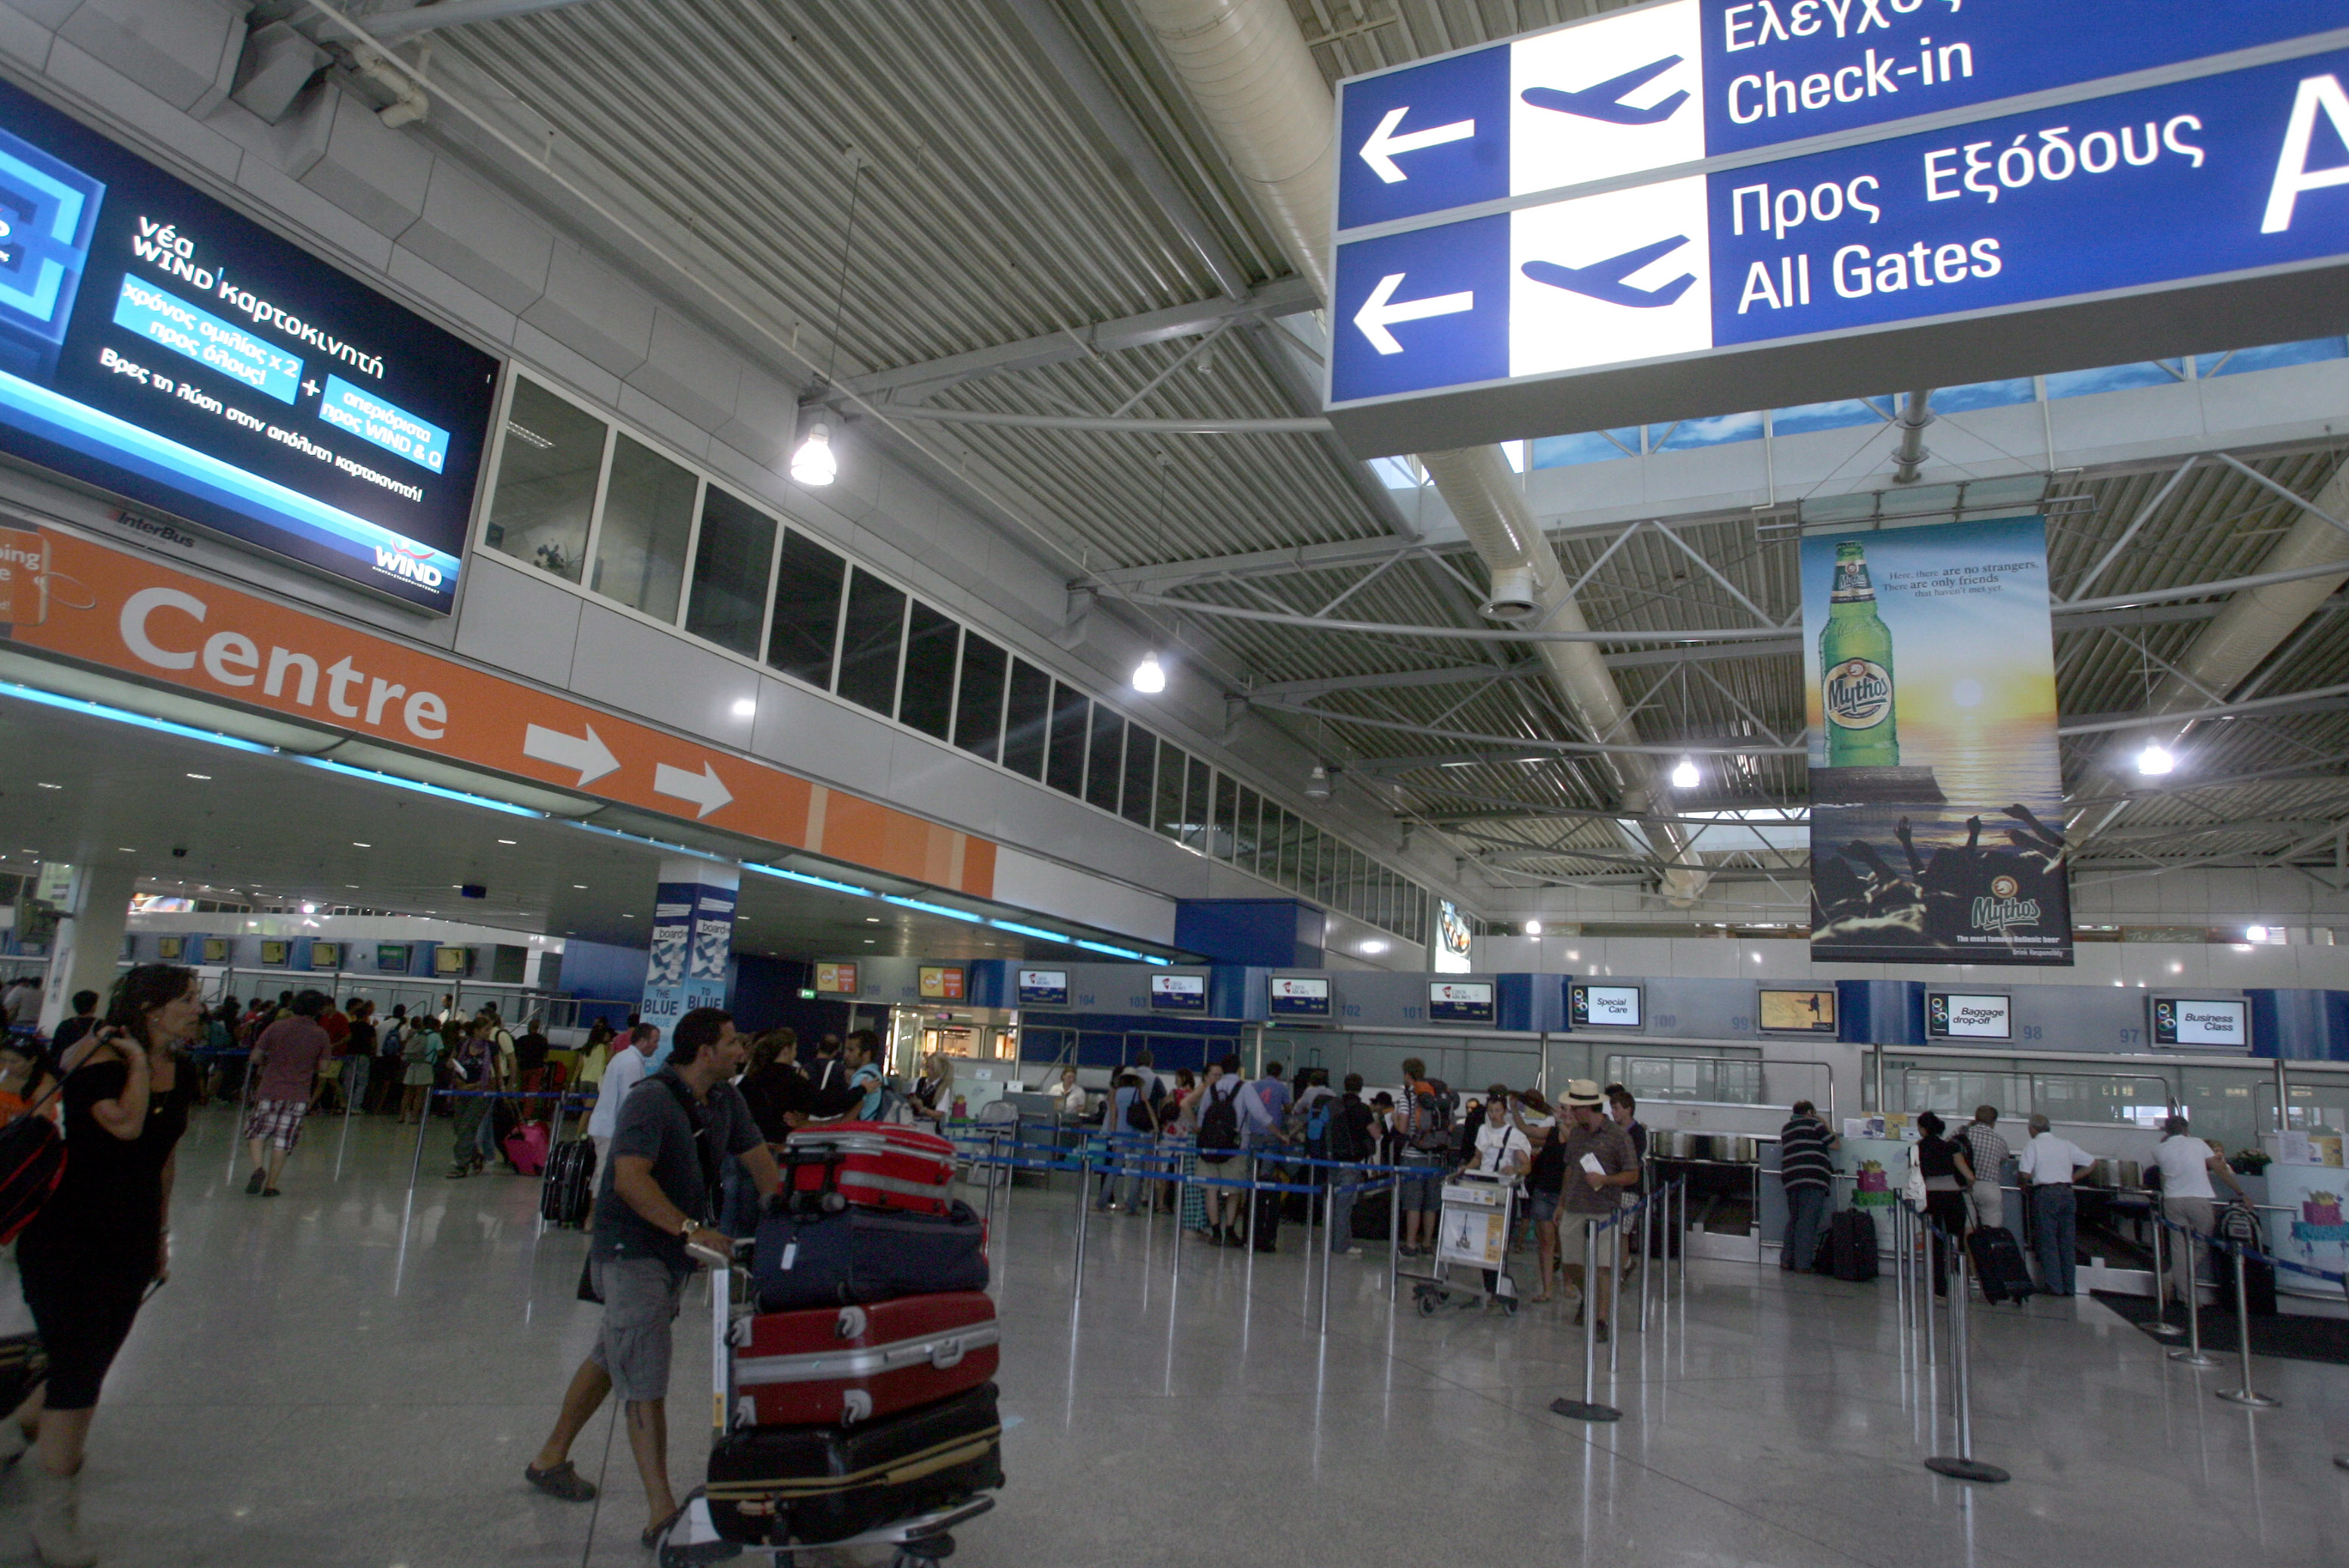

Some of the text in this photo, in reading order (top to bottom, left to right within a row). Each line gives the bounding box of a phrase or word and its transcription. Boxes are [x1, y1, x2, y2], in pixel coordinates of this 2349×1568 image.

[1725, 0, 1962, 52] Ελεγχ
[1728, 36, 1974, 124] Check-in
[1731, 115, 2205, 240] Προς Εξόδους
[139, 216, 194, 259] νέα
[1737, 237, 2002, 314] All Gates
[133, 235, 386, 379] WIND καρτοκινητή
[123, 283, 197, 331] χρόνος
[200, 321, 267, 365] ομιλίας
[284, 359, 300, 378] 2
[150, 321, 266, 385] προς όλους!
[101, 347, 151, 384] Βρες
[153, 373, 174, 393] τη
[176, 382, 224, 415] λύση
[226, 406, 266, 432] στην
[266, 425, 333, 464] απόλυτη
[343, 391, 431, 443] απεριόριστα
[322, 403, 363, 433] προς
[366, 419, 412, 453] WIND
[413, 443, 426, 461] &
[116, 510, 196, 549] InterBus
[375, 545, 442, 587] WIND
[1915, 569, 1939, 578] there
[1942, 566, 1961, 576] are
[1964, 565, 1980, 574] no
[1883, 574, 1999, 592] There are only friends
[1915, 590, 1932, 598] that
[1968, 586, 1987, 594] met
[119, 586, 448, 740] Centre
[1828, 677, 1888, 714] Mythos
[1971, 896, 2041, 932] Mythos
[656, 988, 670, 1000] THE
[701, 986, 711, 997] TO
[1078, 994, 1095, 1006] 104
[643, 999, 679, 1016] BLUE
[1597, 997, 1627, 1007] Special
[1341, 1005, 1361, 1018] 102
[1402, 1006, 1422, 1019] 101
[1952, 1016, 1991, 1025] drop-off
[1962, 1006, 2005, 1018] Baggage
[2185, 1013, 2234, 1023] Business
[1731, 1016, 1749, 1030] 99
[2204, 1022, 2234, 1031] Class
[2023, 1025, 2043, 1040] 98
[2120, 1028, 2139, 1044] 97
